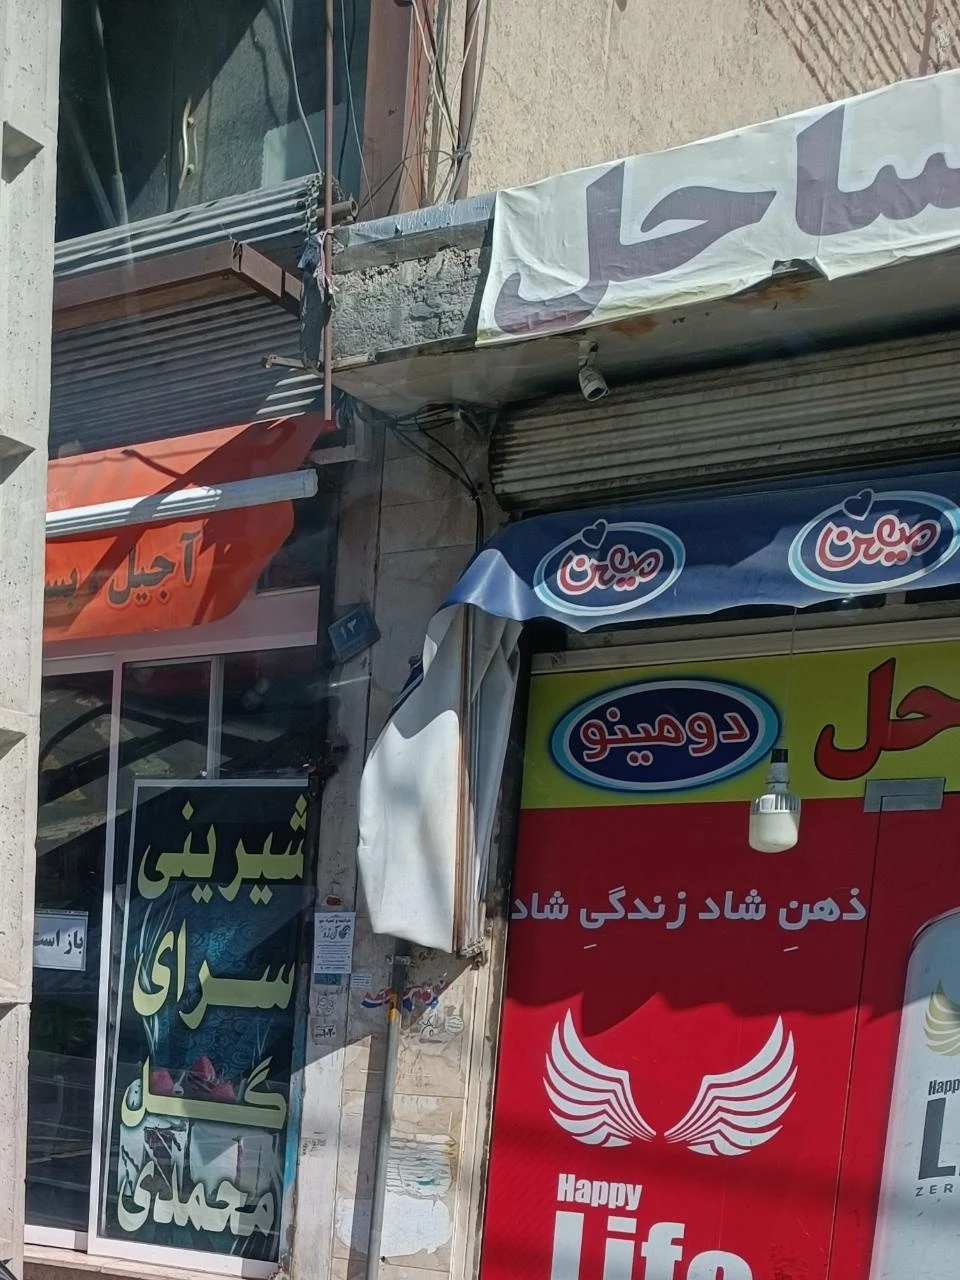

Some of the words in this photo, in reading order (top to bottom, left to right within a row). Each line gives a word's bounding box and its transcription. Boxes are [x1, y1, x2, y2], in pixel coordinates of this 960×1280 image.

[494, 103, 960, 334] ساحل
[107, 529, 202, 607] آجیل
[579, 706, 750, 767] دومینو
[137, 794, 308, 905] شیرینی
[511, 890, 569, 921] شاد
[698, 889, 767, 921] شاد
[63, 929, 84, 955] باز
[133, 918, 295, 1030] سرای
[121, 1055, 287, 1130] گل
[928, 1078, 960, 1096] Happ
[117, 1160, 275, 1237] محمدی
[557, 1173, 643, 1211] Happy
[915, 1183, 954, 1198] ZER
